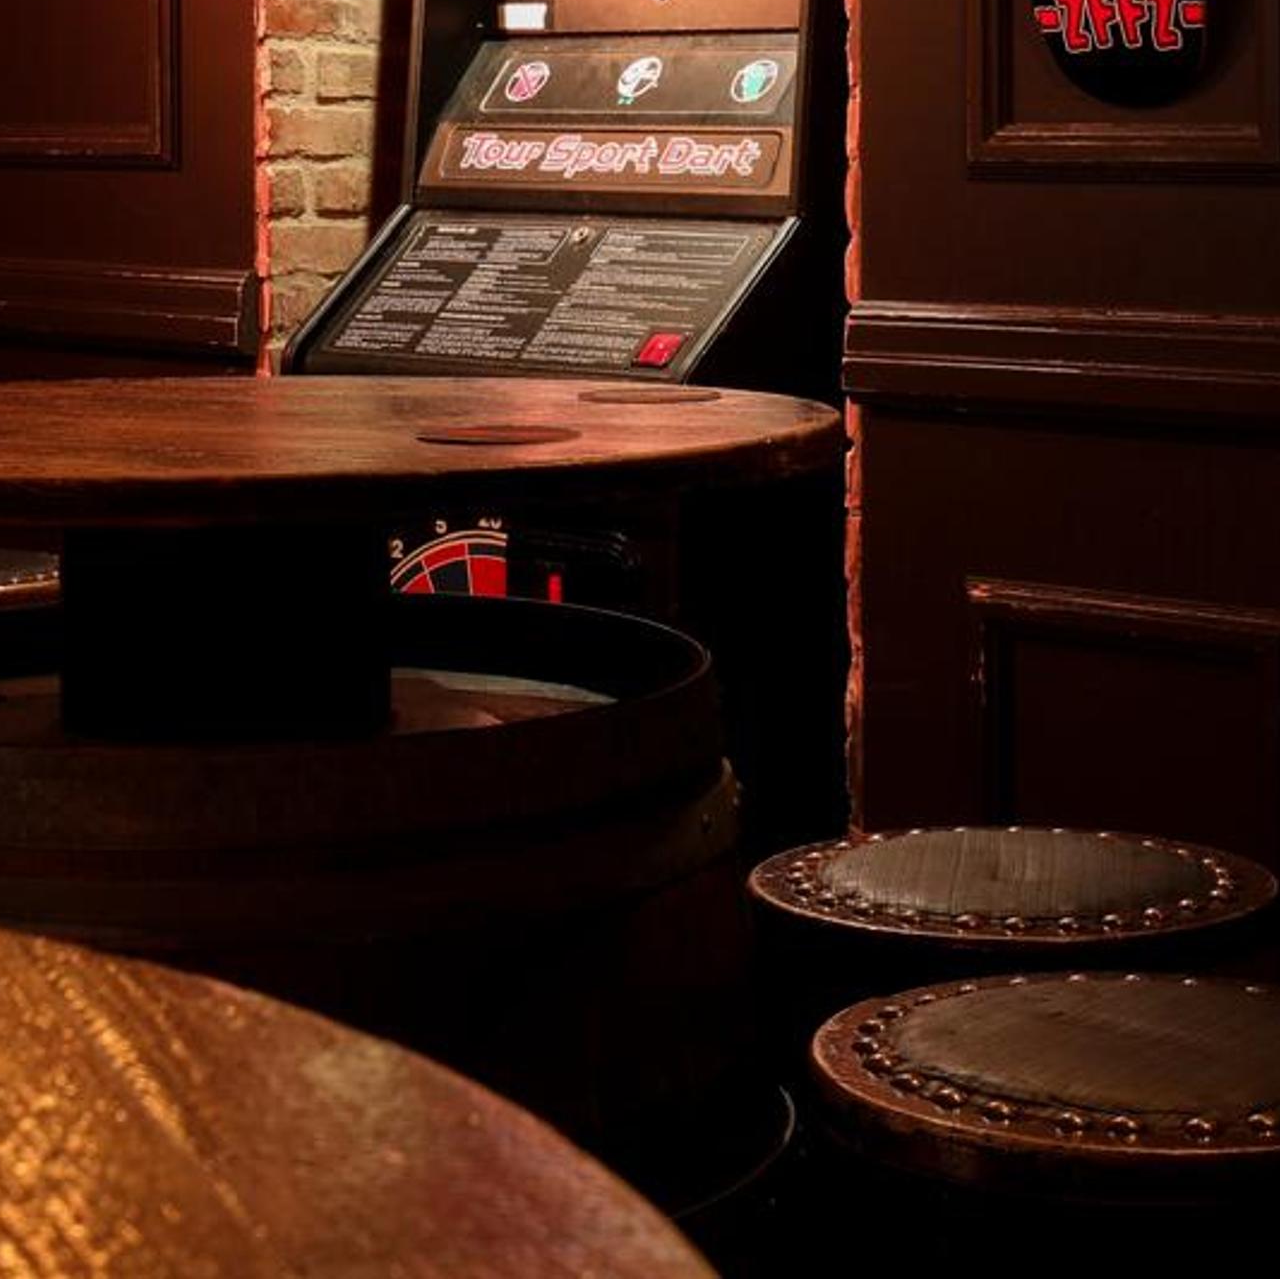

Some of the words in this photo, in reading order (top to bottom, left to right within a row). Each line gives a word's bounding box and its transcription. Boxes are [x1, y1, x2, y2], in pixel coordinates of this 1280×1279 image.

[461, 132, 546, 169] Tour
[539, 133, 659, 179] Sport
[658, 136, 762, 176] Dart
